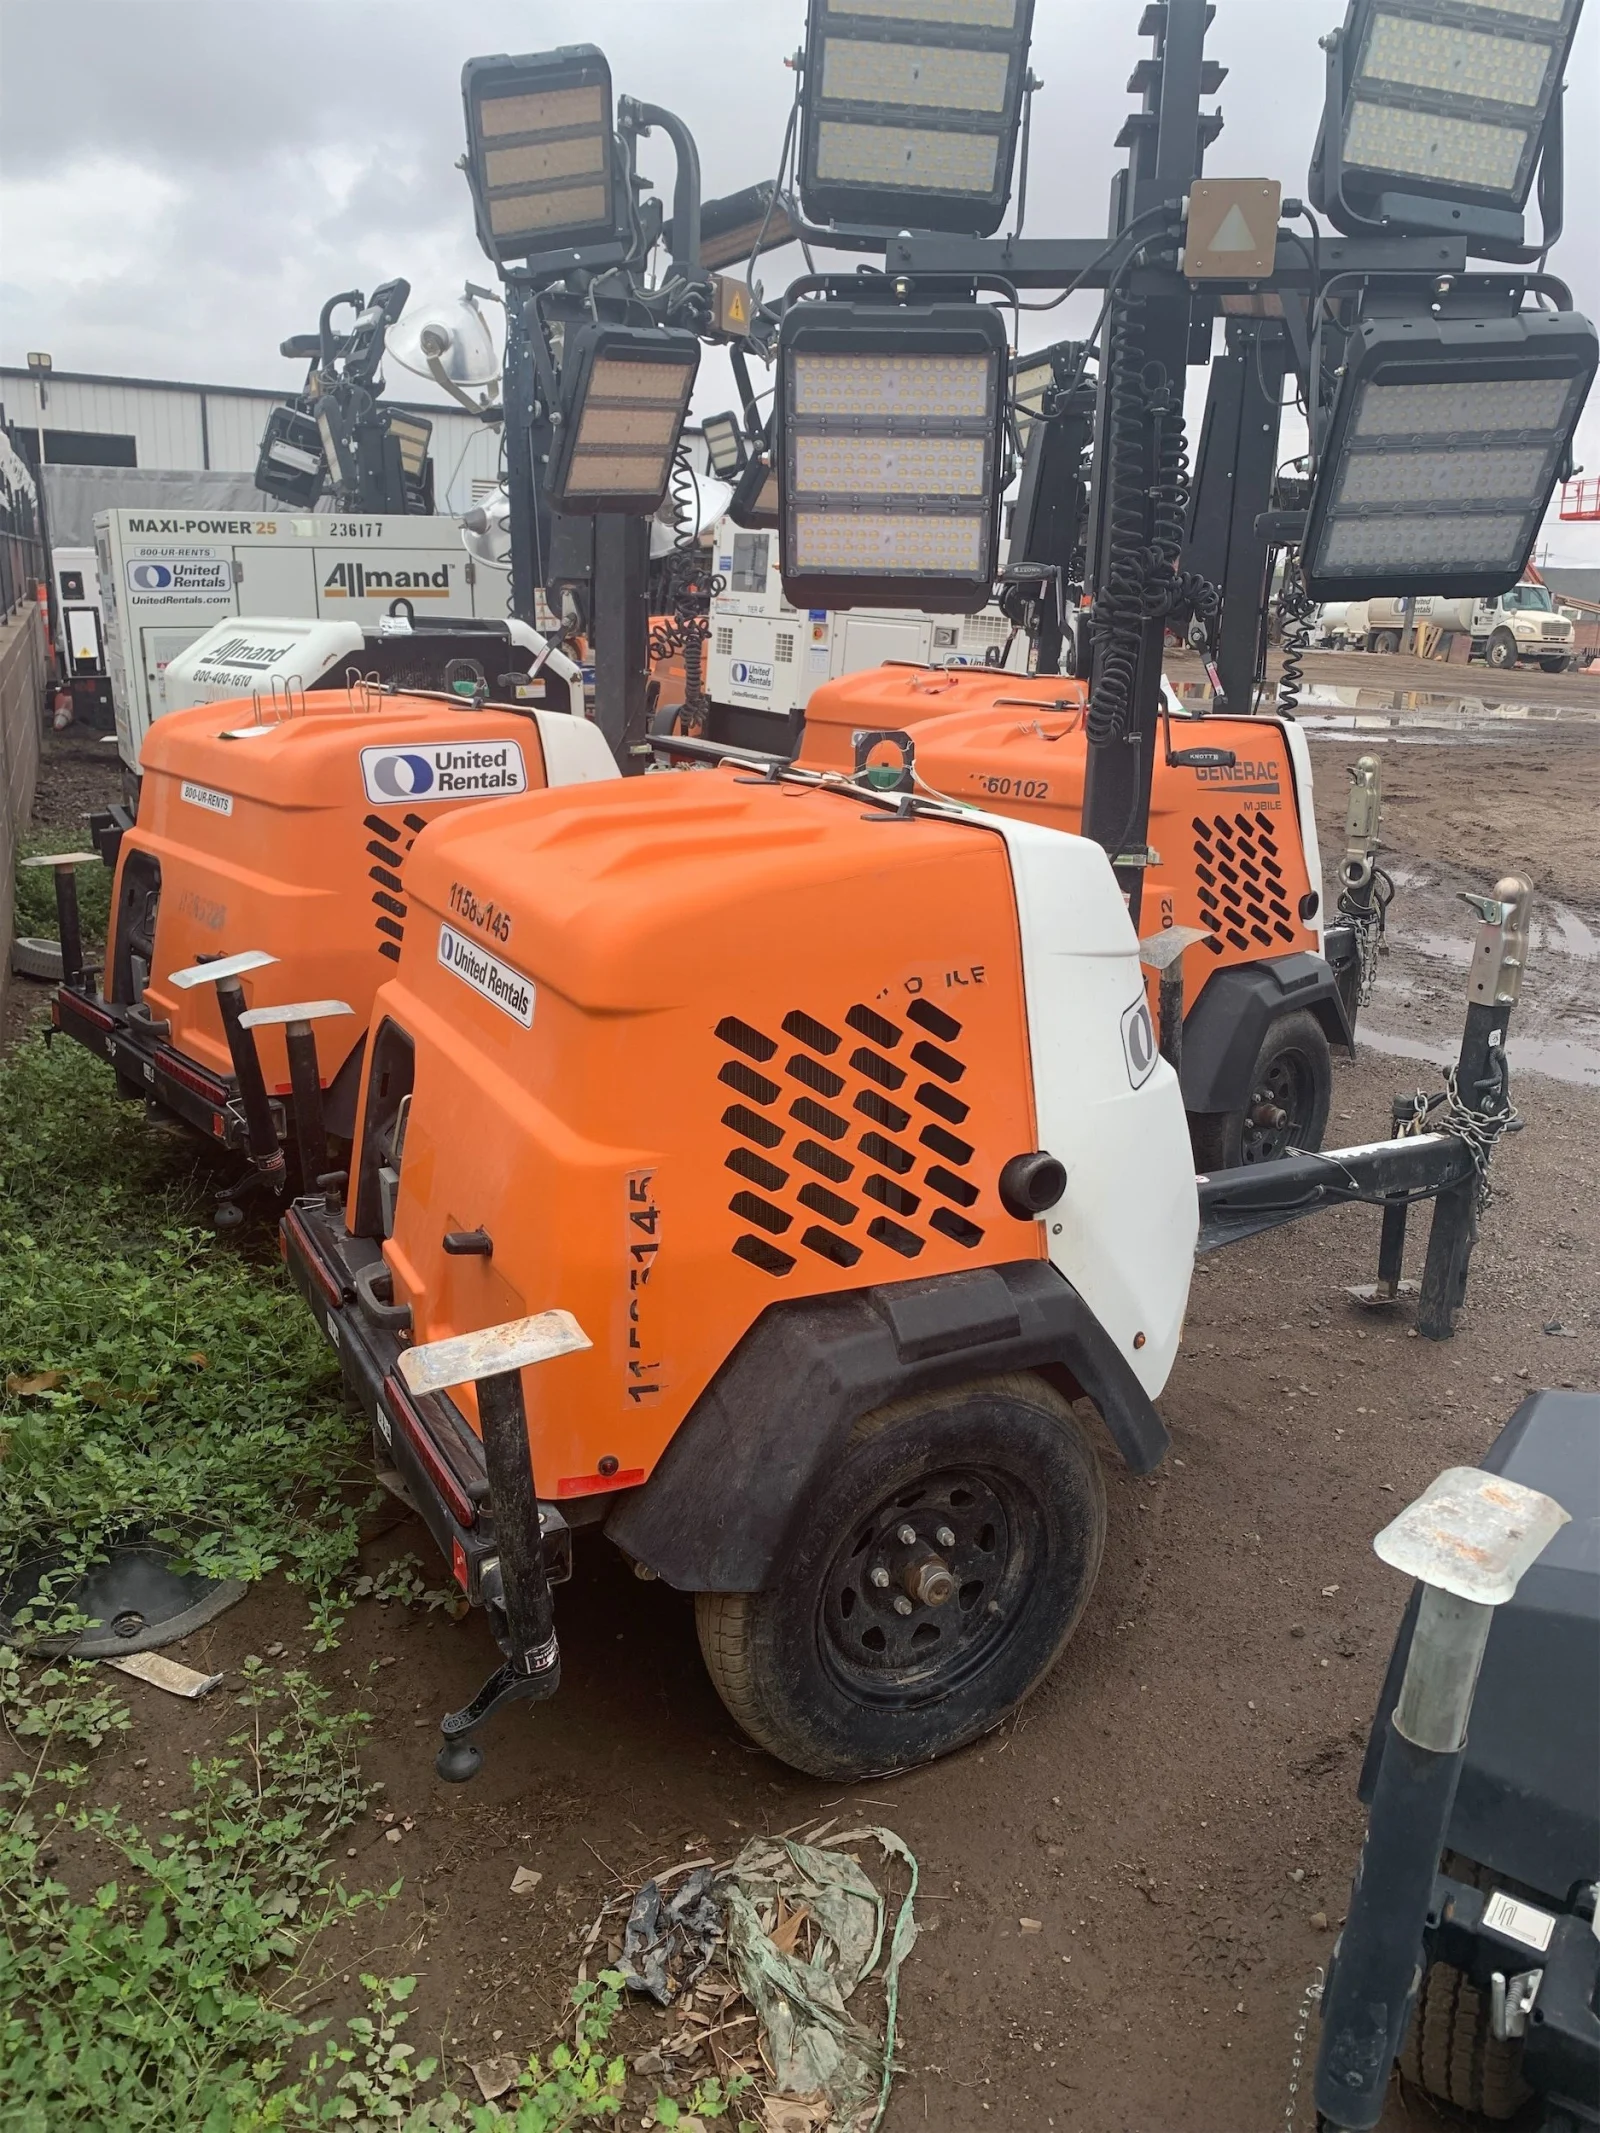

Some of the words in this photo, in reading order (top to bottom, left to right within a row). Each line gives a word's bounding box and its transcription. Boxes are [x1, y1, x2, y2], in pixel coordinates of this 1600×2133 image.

[256, 521, 278, 535] 25
[330, 523, 383, 538] 236177
[139, 549, 211, 557] 800-UR-RENTS
[172, 564, 220, 576] United
[173, 576, 226, 588] Rentals
[324, 562, 449, 598] Allmand
[131, 596, 231, 606] UnitedRentals.com
[1414, 605, 1432, 614] entals
[208, 638, 296, 665] Allmand
[748, 664, 771, 677] United
[192, 669, 253, 688] 800-400-1610
[747, 674, 772, 687] Rentals
[731, 690, 770, 701] UnitedRentals.com
[435, 749, 508, 771] United
[1195, 761, 1280, 781] GENERAC
[437, 769, 518, 792] Rentals
[184, 786, 230, 811] 800-UR-RENTS
[454, 942, 488, 986] United
[487, 964, 529, 1016] Rentals
